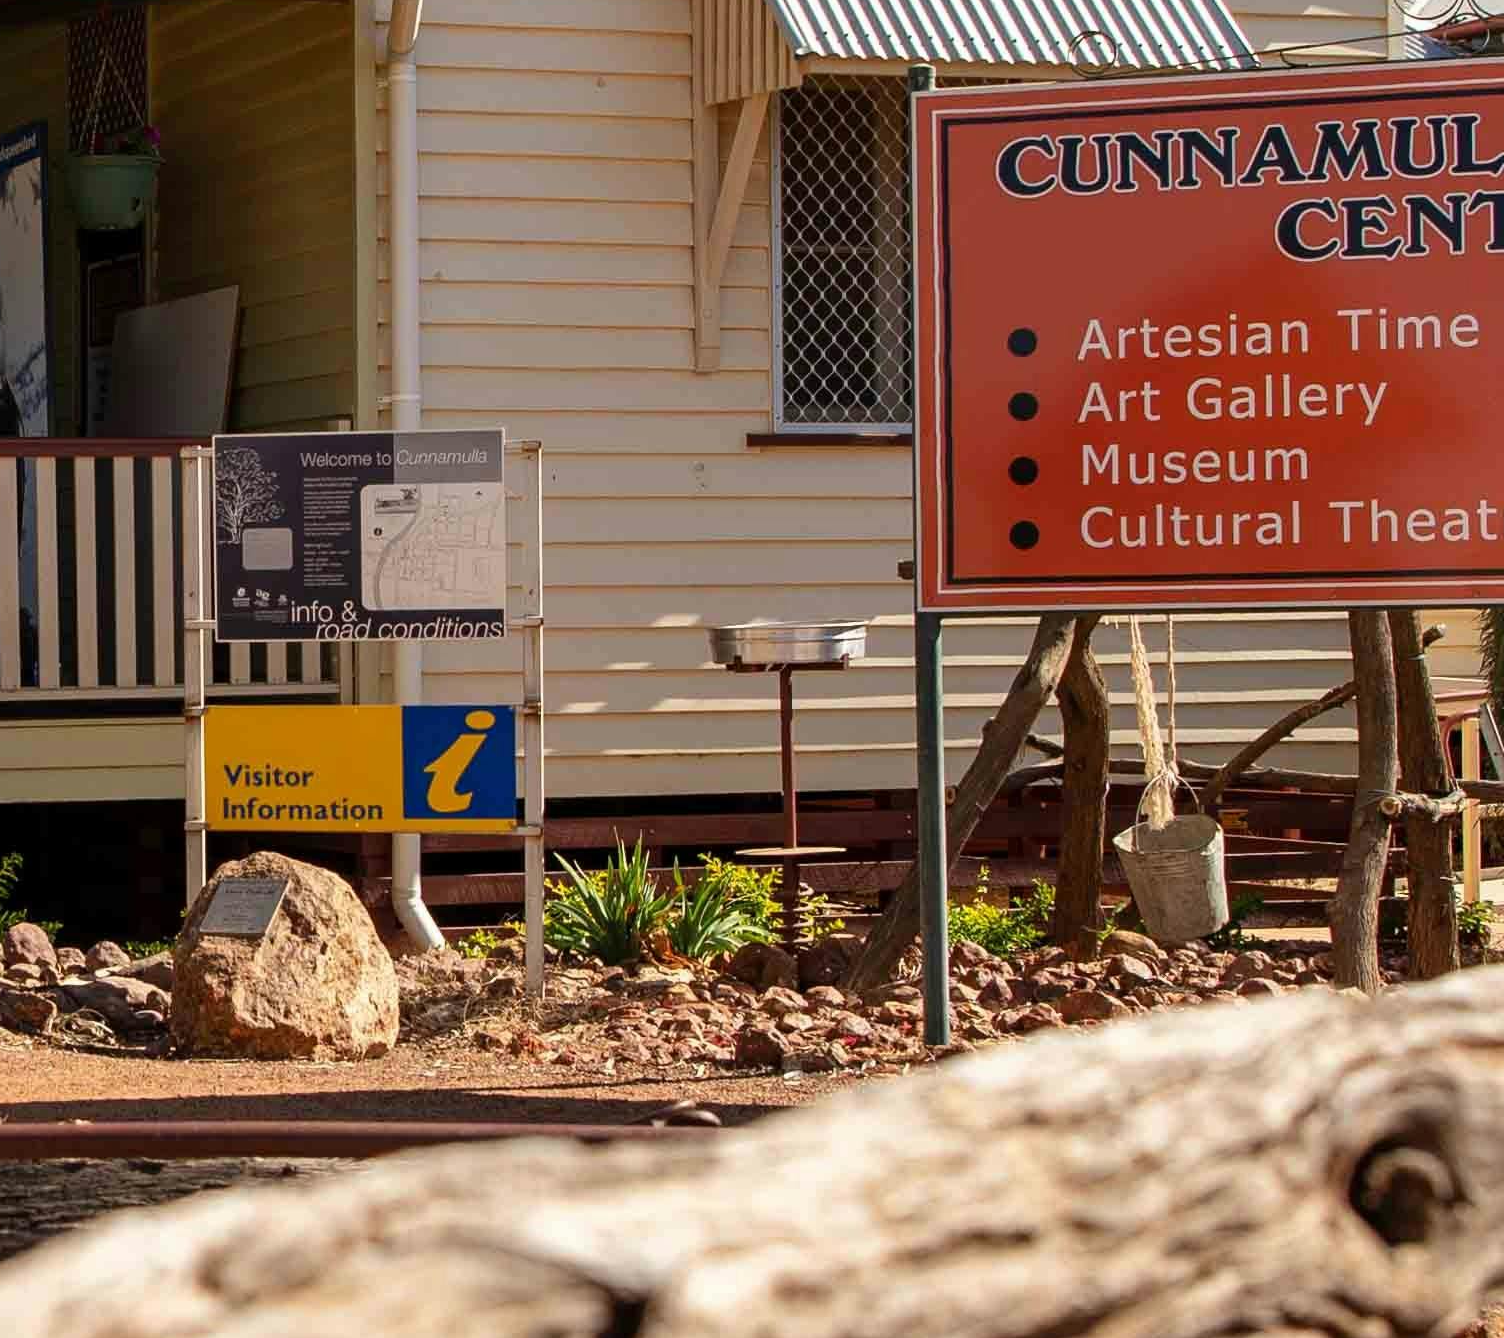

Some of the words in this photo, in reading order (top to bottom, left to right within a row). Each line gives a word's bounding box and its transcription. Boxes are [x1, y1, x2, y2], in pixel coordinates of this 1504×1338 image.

[1077, 313, 1311, 361] Artesian
[1337, 308, 1480, 352] Time
[1077, 381, 1161, 424] Art
[1186, 374, 1388, 426] Gallery
[300, 451, 372, 468] Welcome
[374, 452, 392, 467] to
[396, 448, 488, 466] Cunnamulla
[1080, 443, 1311, 485] Museum
[1080, 500, 1302, 549] Cultural
[291, 600, 334, 623] info
[341, 601, 359, 623] &
[315, 617, 371, 640] road
[378, 616, 503, 640] conditions
[223, 764, 315, 788] Visitor
[223, 797, 384, 821] Information
